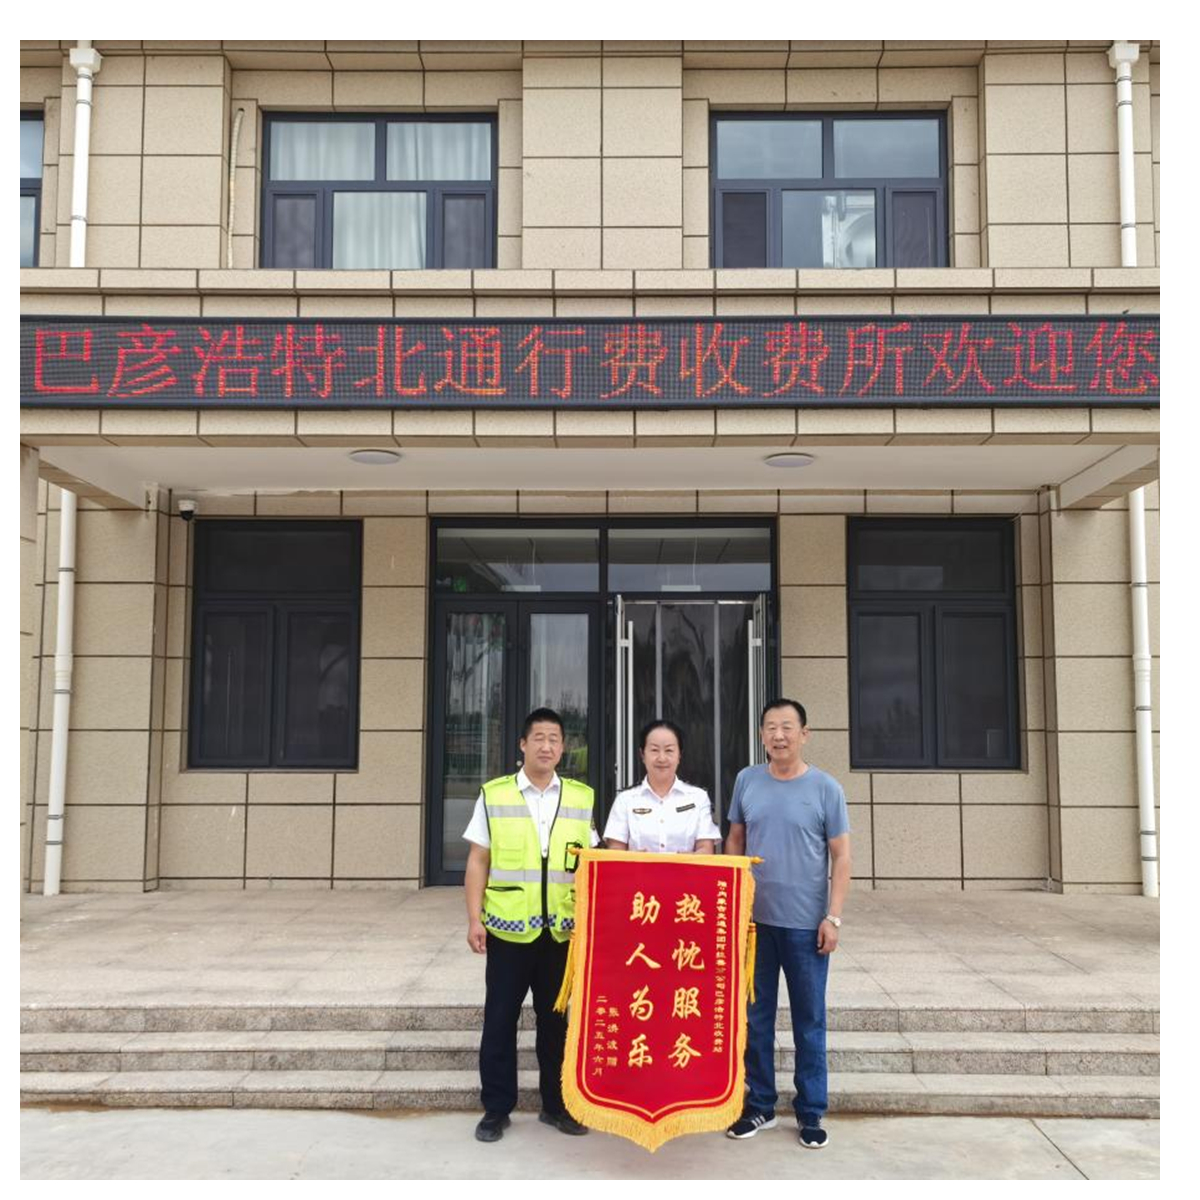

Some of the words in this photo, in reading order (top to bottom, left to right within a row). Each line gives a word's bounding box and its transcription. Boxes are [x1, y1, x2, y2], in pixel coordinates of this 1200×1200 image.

[34, 321, 1159, 397] 巴彦浩特北通行费收费所欢迎您
[625, 891, 662, 1068] 助人为乐
[668, 892, 706, 1069] 热忱服务
